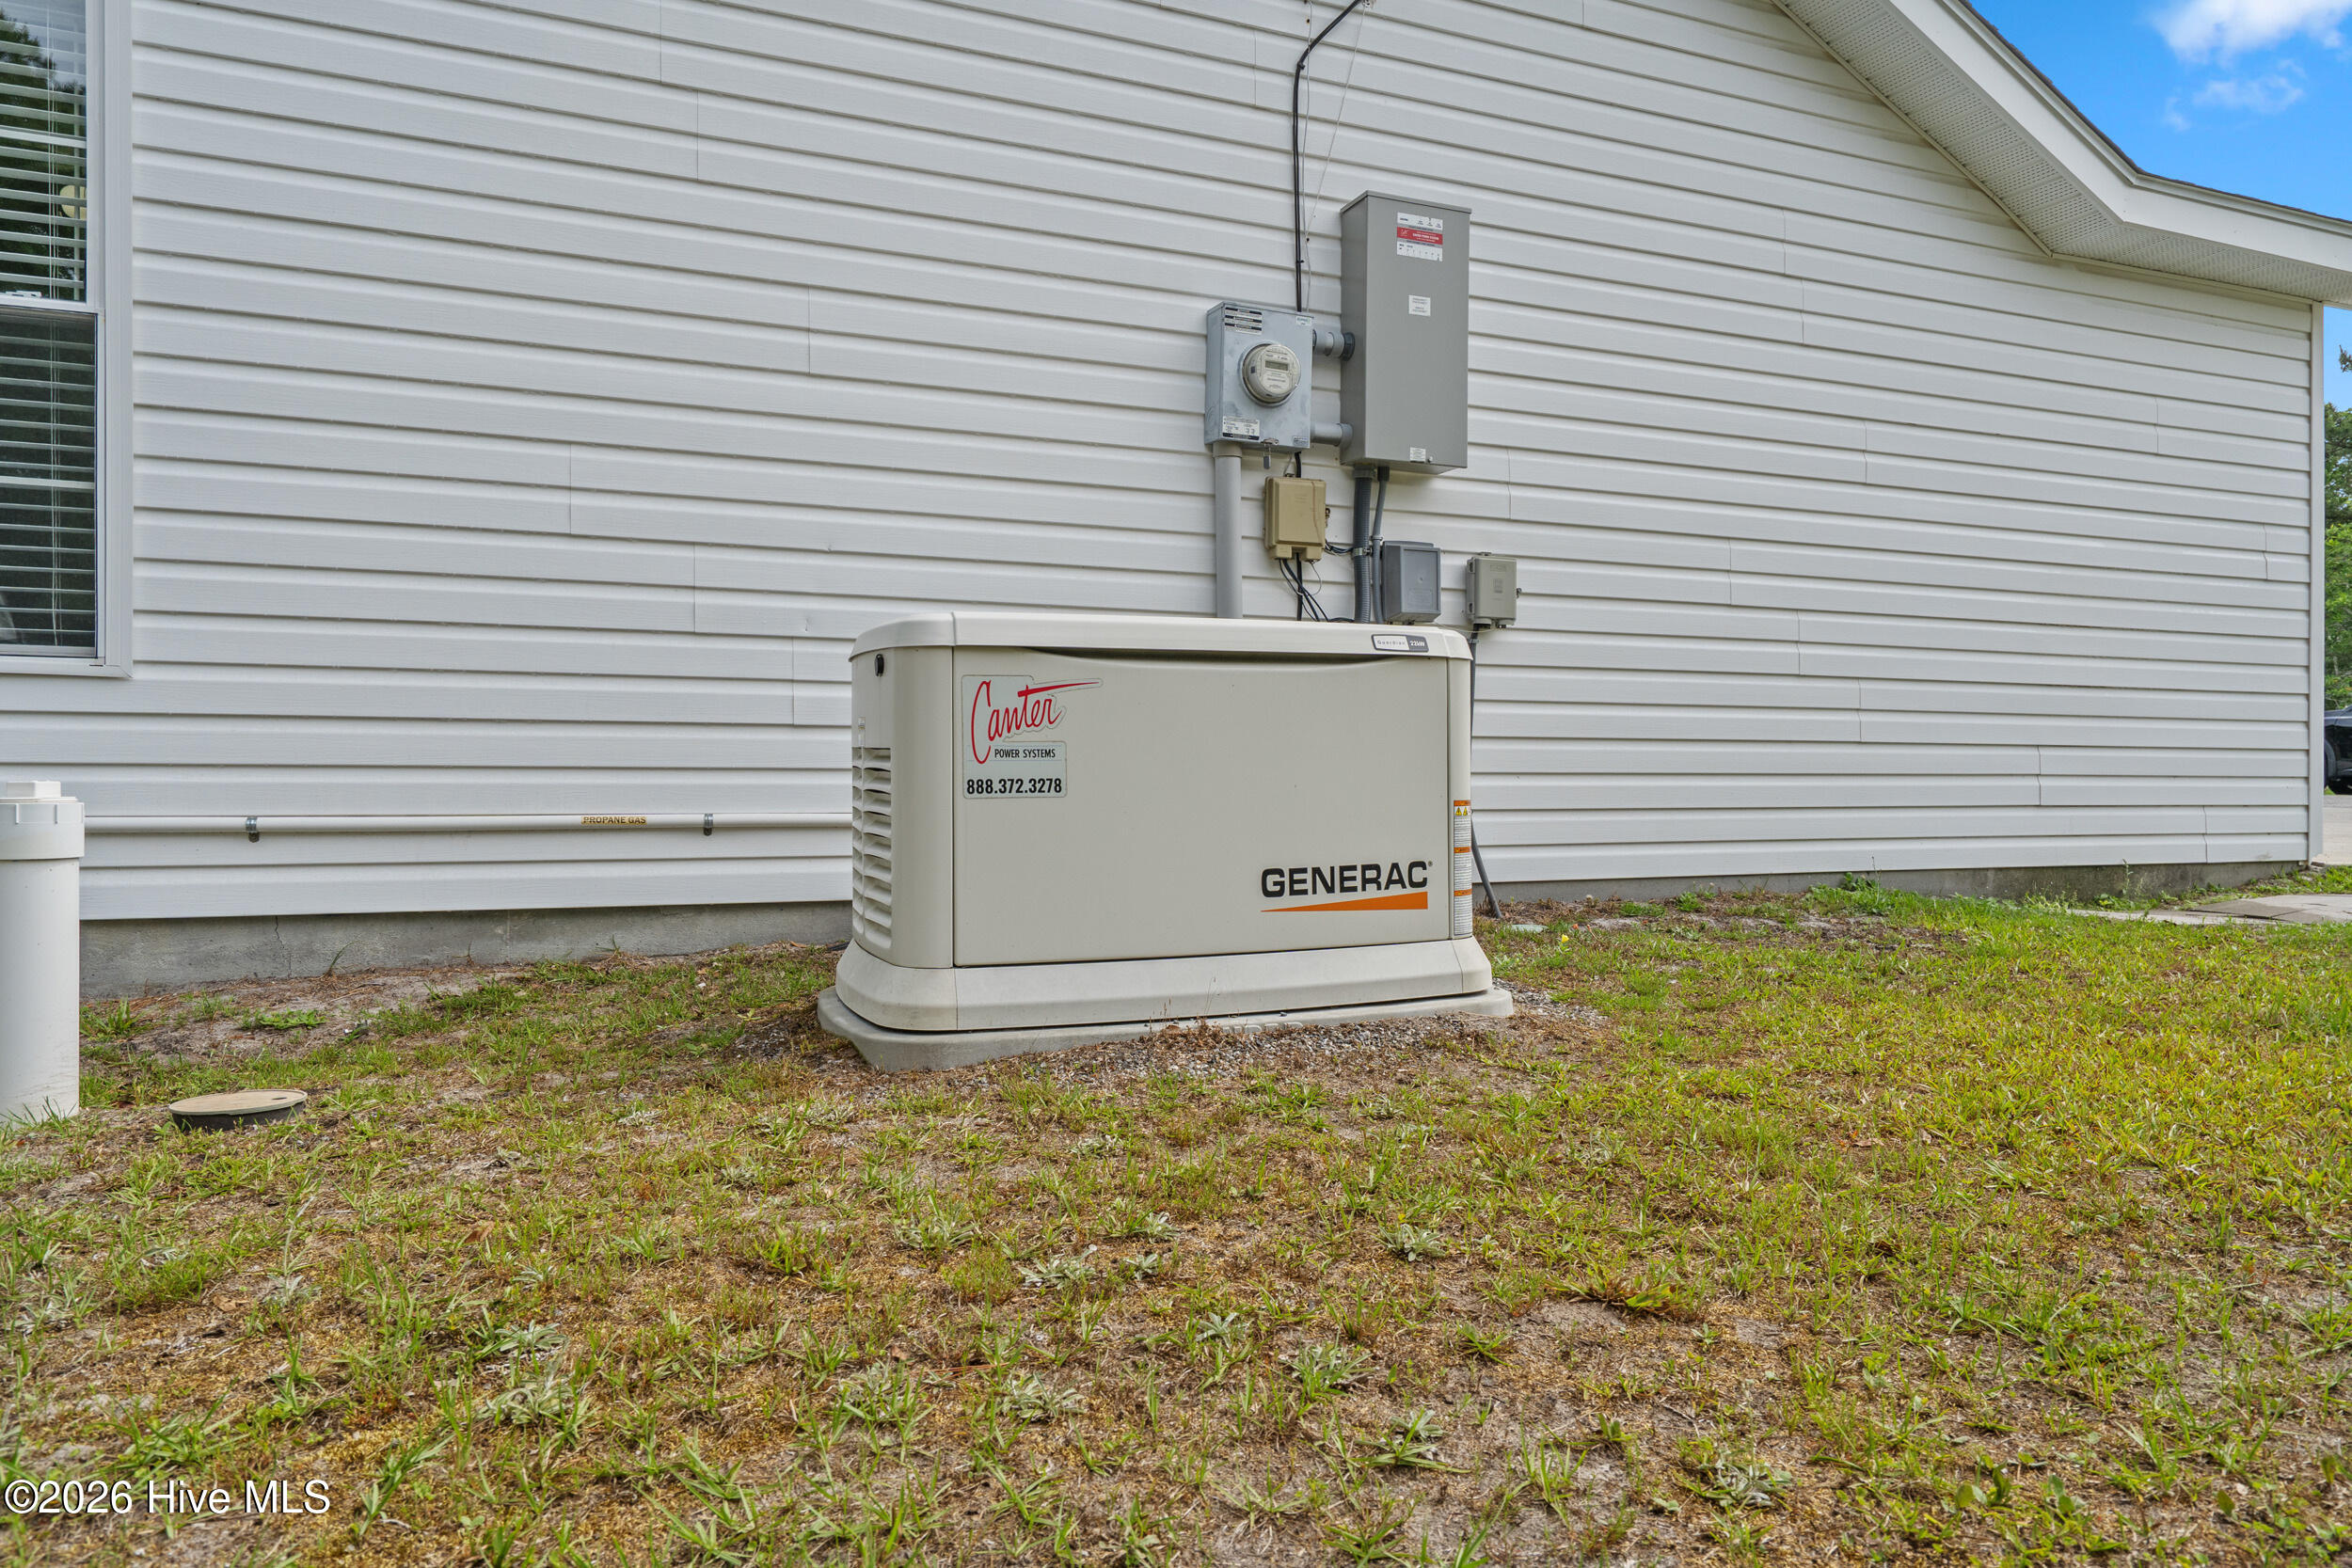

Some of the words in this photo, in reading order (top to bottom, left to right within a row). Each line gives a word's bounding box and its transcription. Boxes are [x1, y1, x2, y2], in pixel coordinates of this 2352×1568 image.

[971, 679, 1099, 764] Canter
[994, 749, 1020, 758] POWER
[1023, 748, 1056, 758] SYSTEMS
[966, 778, 1062, 795] 888.372.3278
[1261, 861, 1428, 898] GENERAC
